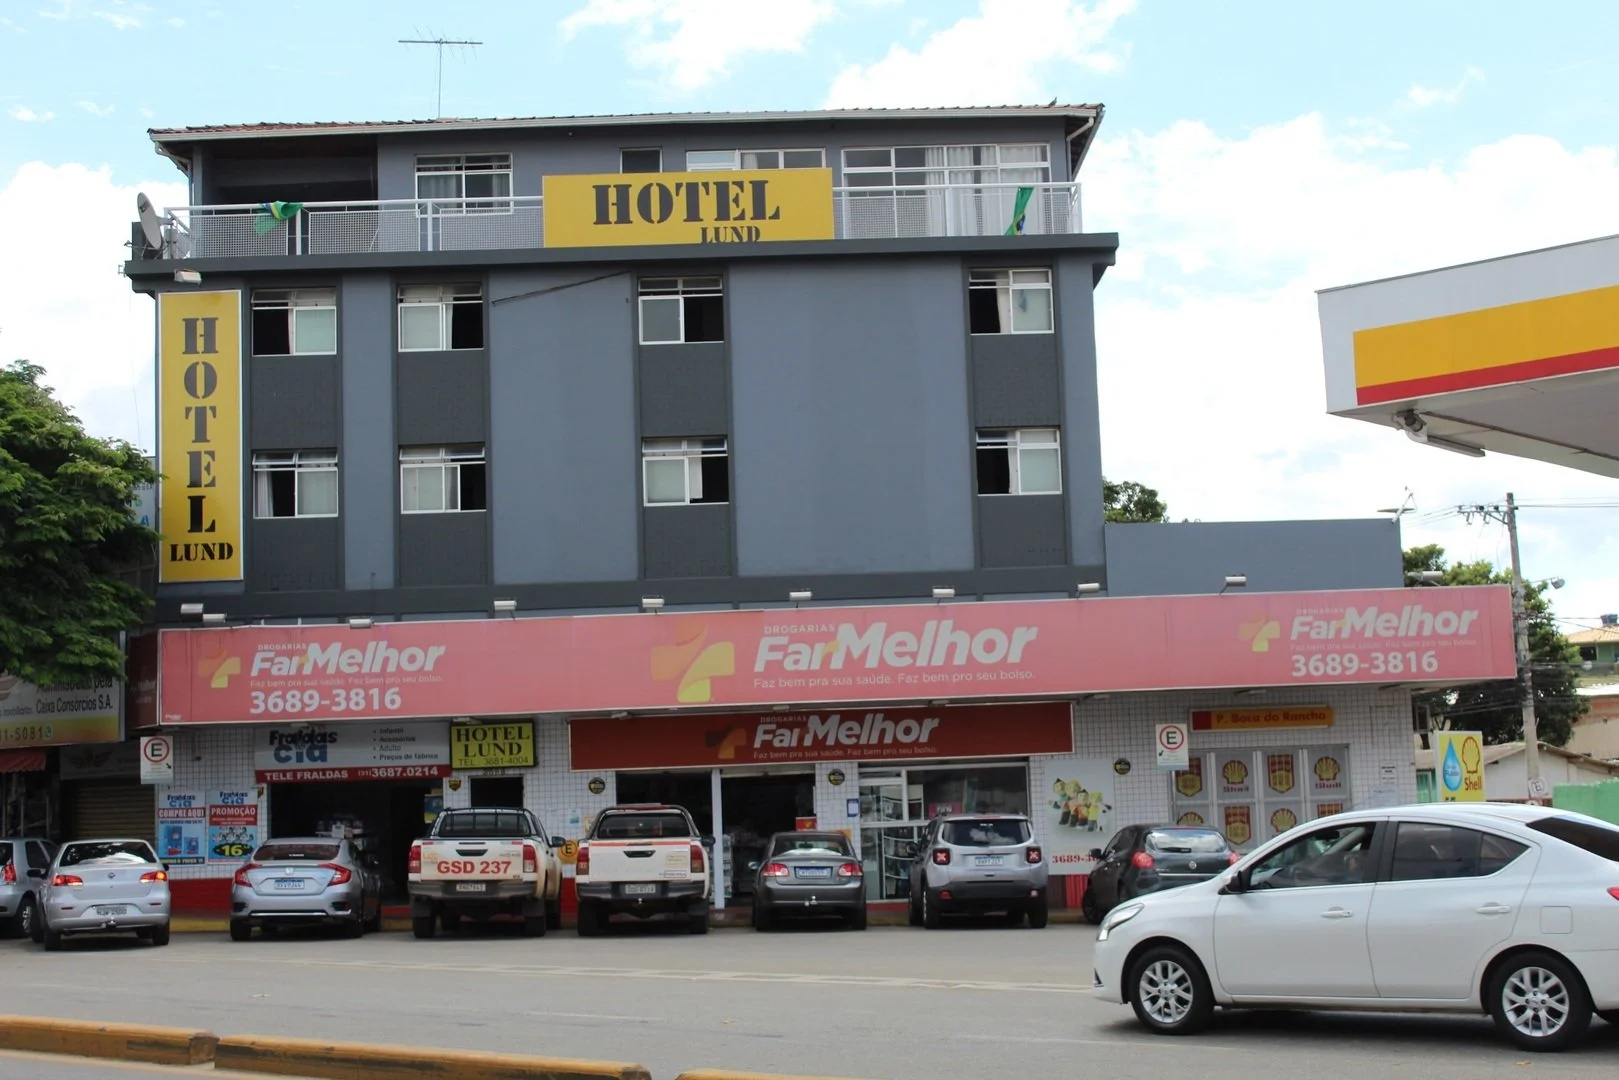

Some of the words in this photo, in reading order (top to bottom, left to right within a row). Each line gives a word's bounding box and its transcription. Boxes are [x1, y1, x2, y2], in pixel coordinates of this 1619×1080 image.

[592, 180, 780, 225] HOTEL
[700, 226, 761, 243] LUND
[182, 316, 219, 533] HOTEL
[169, 542, 234, 562] LUND
[764, 623, 836, 635] DROGARIAS
[1290, 605, 1479, 641] FarMelhor
[257, 643, 307, 651] DROGARIAS
[753, 619, 1039, 673] FarMelhor
[250, 640, 446, 677] FarMelhor
[1291, 650, 1439, 678] 3689-3816
[267, 679, 286, 688] bem
[287, 681, 301, 690] pra
[365, 676, 384, 685] bem
[385, 677, 401, 687] pro
[753, 678, 776, 689] Faz
[779, 676, 805, 687] bem
[809, 678, 829, 690] pra
[832, 677, 852, 686] sua
[898, 673, 919, 683] Faz
[922, 672, 949, 682] bem
[952, 674, 973, 685] pro
[976, 672, 997, 681] seu
[1000, 670, 1037, 681] bolso.
[36, 698, 55, 714] Caixa
[98, 694, 113, 710] S.A.
[250, 686, 401, 714] 3689-3816
[1264, 712, 1279, 722] do
[1283, 711, 1326, 721] Rancho
[269, 729, 338, 745] Fraldas
[456, 726, 530, 742] HOTEL
[753, 712, 940, 749] FarMelhor
[1166, 731, 1177, 744] E
[151, 743, 163, 757] E
[463, 742, 522, 757] LUND
[770, 751, 787, 759] bem
[789, 752, 803, 761] pra
[804, 750, 818, 758] sua
[864, 747, 881, 755] bem
[883, 748, 898, 757] pro
[264, 771, 294, 781] TELE
[296, 769, 349, 780] FRALDAS
[1464, 776, 1483, 791] Shell
[187, 808, 205, 818] AQUI
[211, 807, 256, 816] PROMOÇÃO
[222, 844, 243, 856] 16
[565, 844, 573, 854] E
[437, 860, 475, 874] GSD
[480, 860, 512, 874] 237
